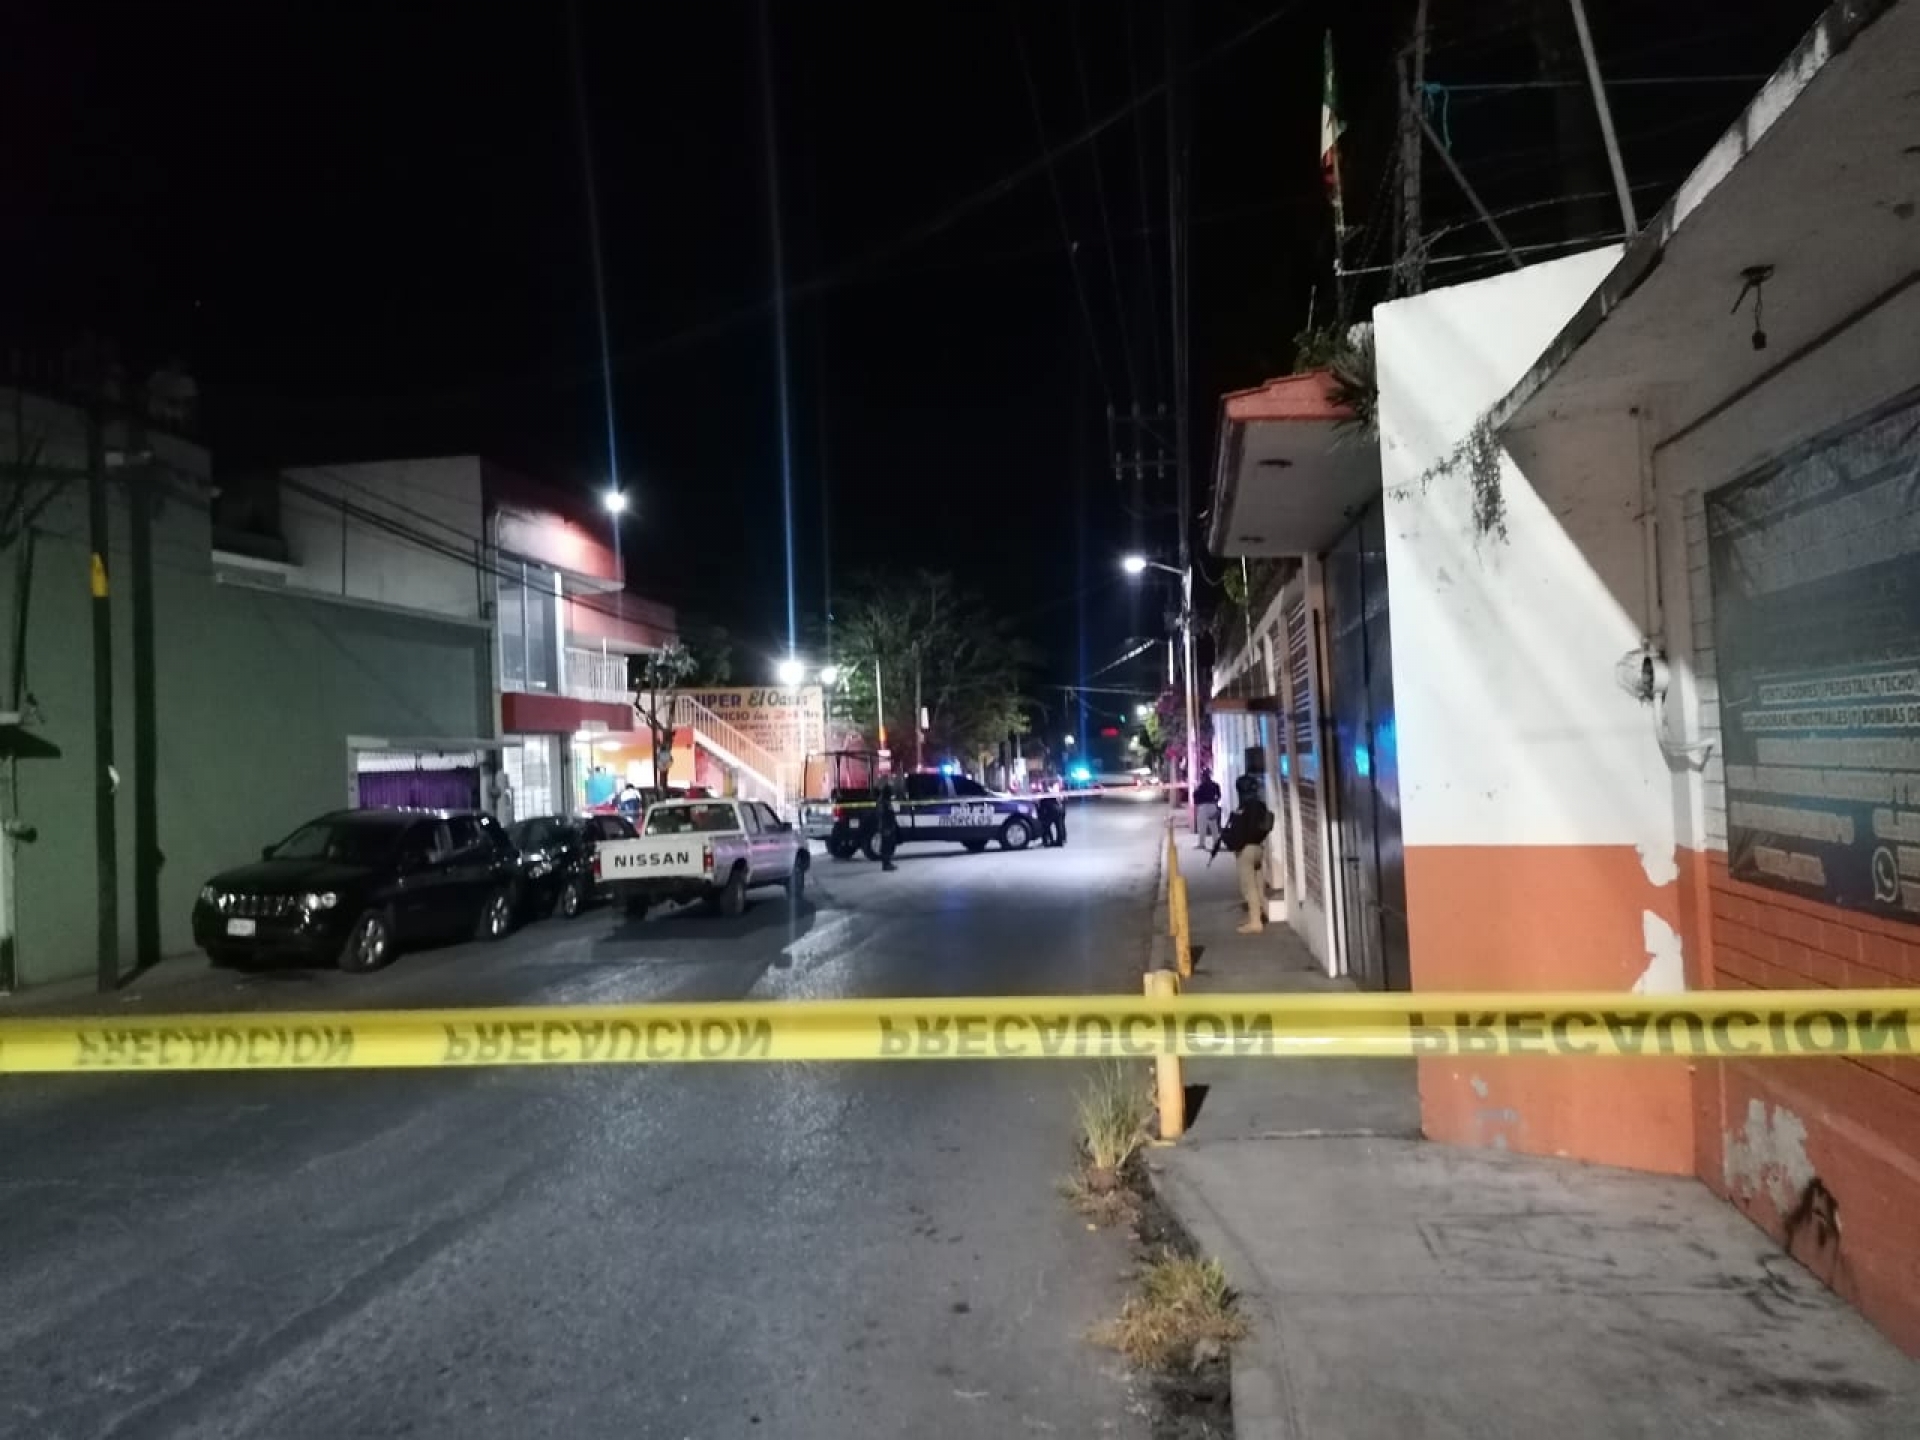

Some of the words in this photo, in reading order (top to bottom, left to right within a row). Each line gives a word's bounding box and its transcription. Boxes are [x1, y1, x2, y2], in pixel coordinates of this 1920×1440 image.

[1879, 673, 1914, 693] TECHO
[1862, 706, 1906, 725] BOMBAS
[614, 851, 690, 868] NISSAN
